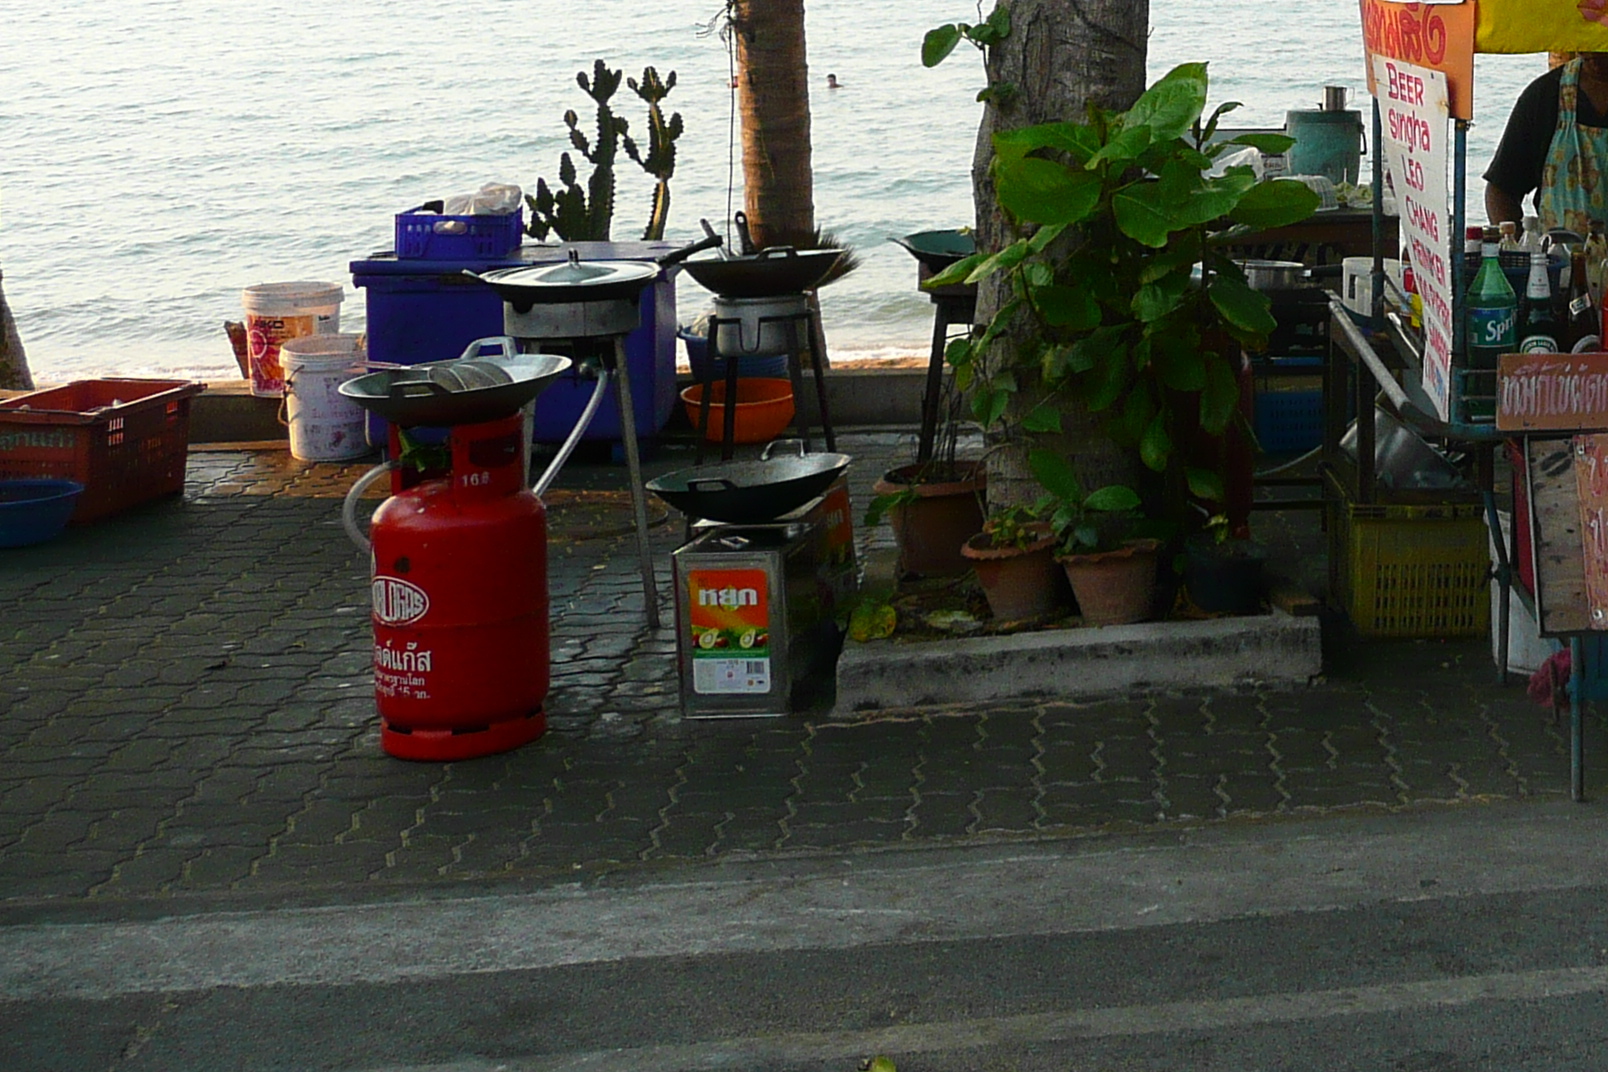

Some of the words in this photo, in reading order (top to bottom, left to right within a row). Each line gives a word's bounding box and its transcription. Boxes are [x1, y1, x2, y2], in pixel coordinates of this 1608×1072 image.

[1386, 62, 1424, 107] BEER
[1401, 153, 1424, 192] LEO
[1405, 195, 1438, 243] CHANG
[699, 588, 758, 607] หยก
